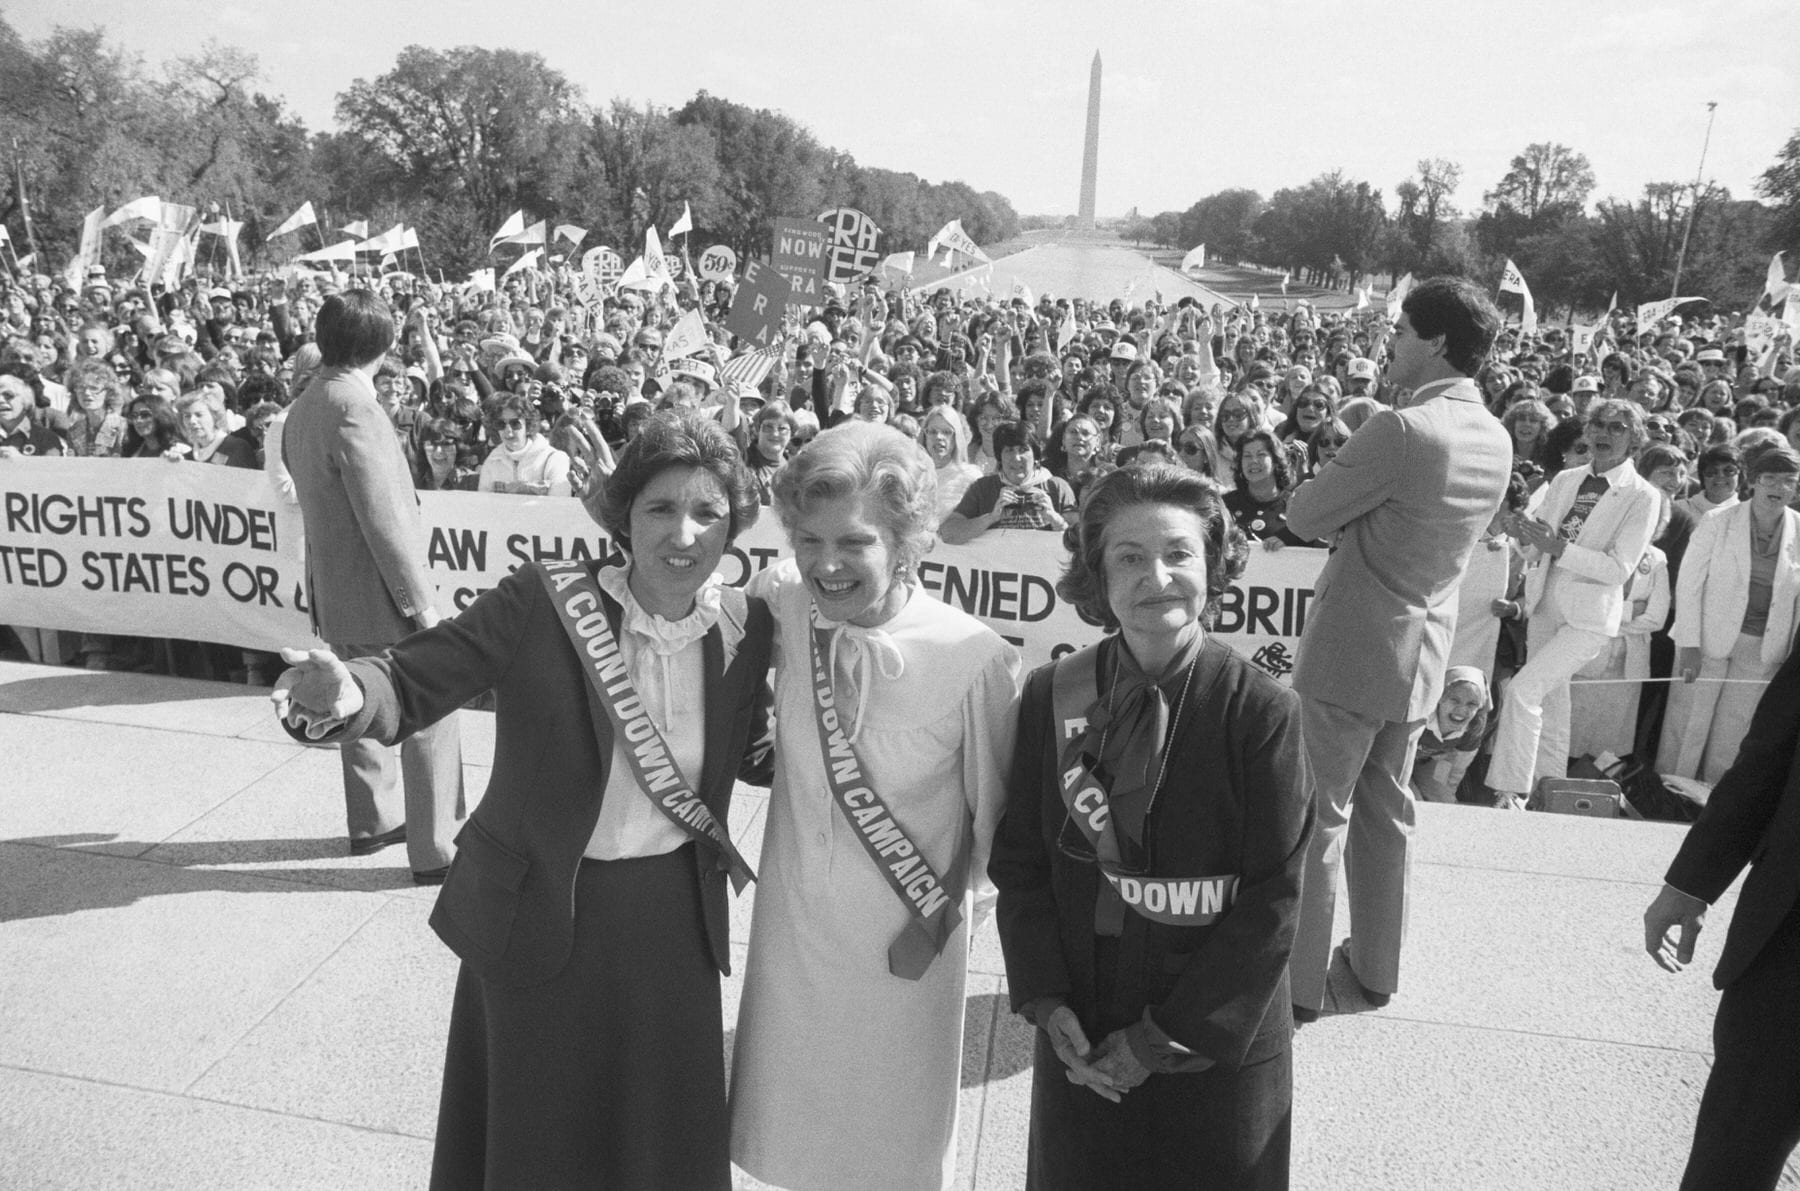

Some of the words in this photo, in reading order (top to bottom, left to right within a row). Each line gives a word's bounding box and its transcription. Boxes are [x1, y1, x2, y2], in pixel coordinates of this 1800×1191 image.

[779, 236, 824, 258] NOW
[961, 240, 977, 255] YES
[1503, 269, 1521, 287] ERA
[5, 492, 150, 538] RIGHTS
[428, 527, 488, 572] AW
[82, 551, 210, 597] STATES
[222, 562, 284, 608] OR
[843, 787, 951, 919] CAMPAIGN
[1120, 878, 1223, 915] DOWN
